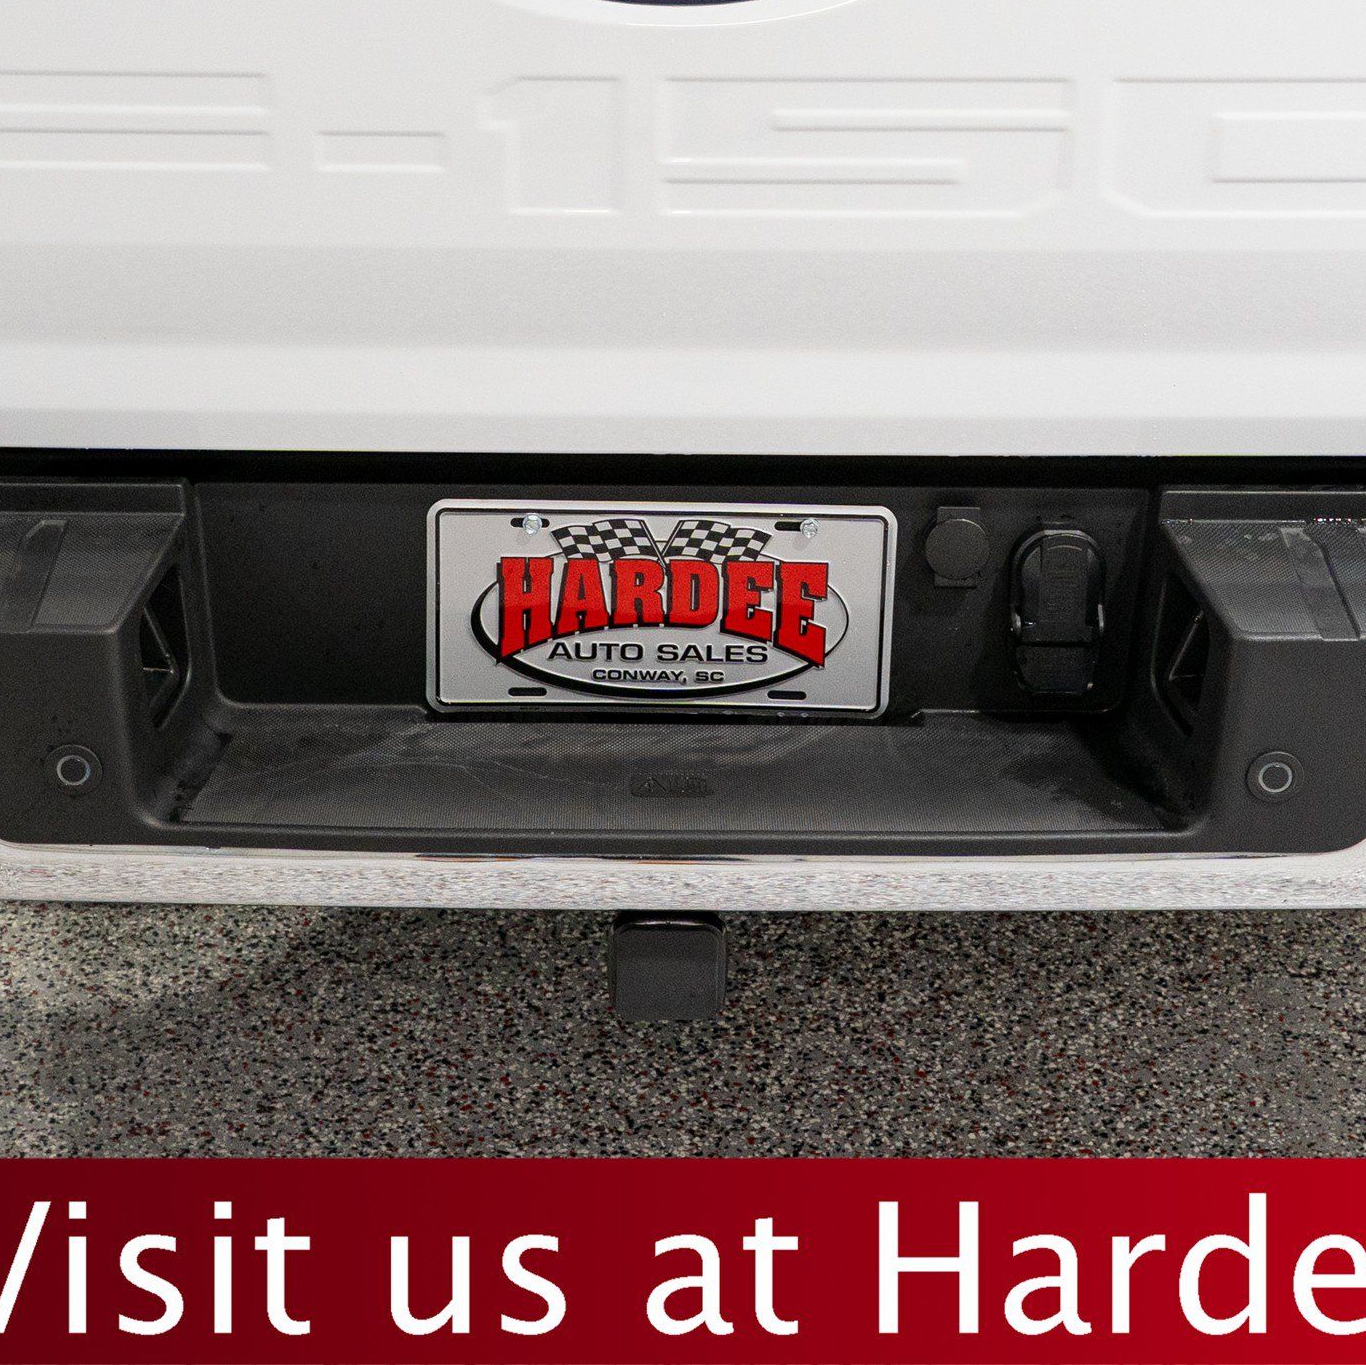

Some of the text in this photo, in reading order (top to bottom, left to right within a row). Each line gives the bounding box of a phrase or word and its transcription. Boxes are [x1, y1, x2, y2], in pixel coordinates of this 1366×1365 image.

[497, 556, 830, 667] HARDEE
[547, 642, 768, 664] AUTO SALES
[592, 668, 724, 684] CONWAY, SC
